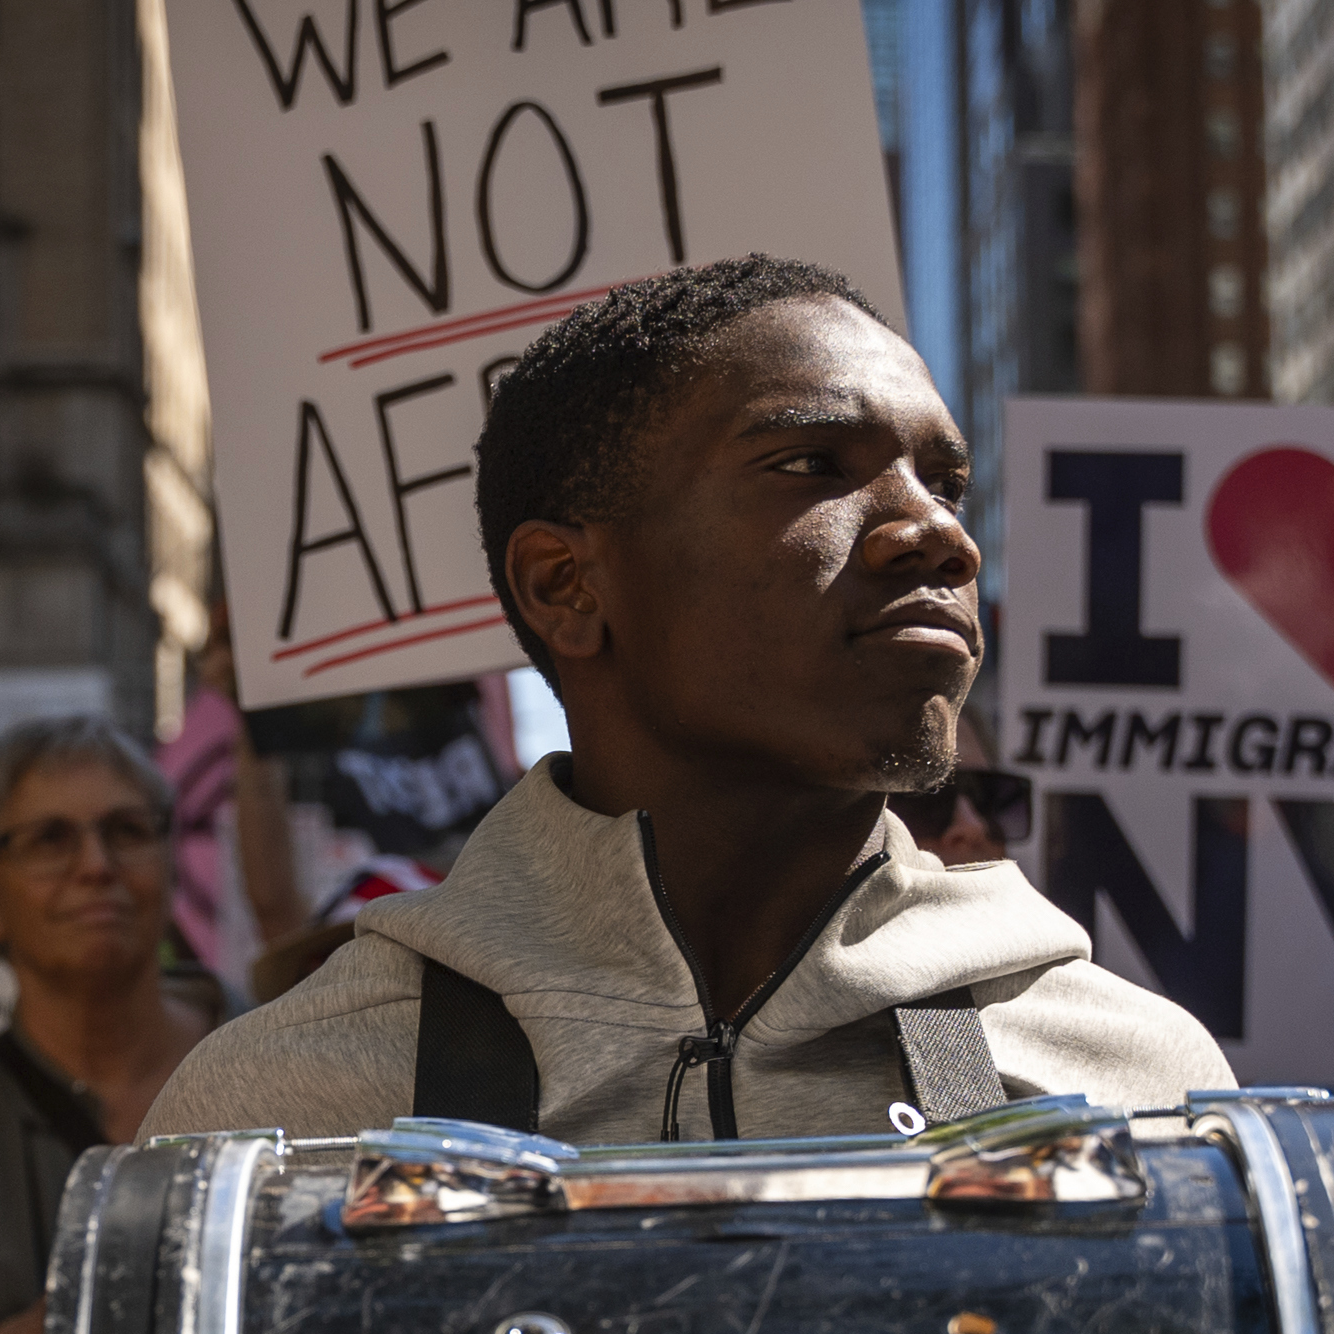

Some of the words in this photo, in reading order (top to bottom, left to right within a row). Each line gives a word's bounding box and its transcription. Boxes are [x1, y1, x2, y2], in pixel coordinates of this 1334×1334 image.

[321, 66, 723, 332] NOT
[277, 355, 525, 640] AF
[1043, 450, 1184, 688] I
